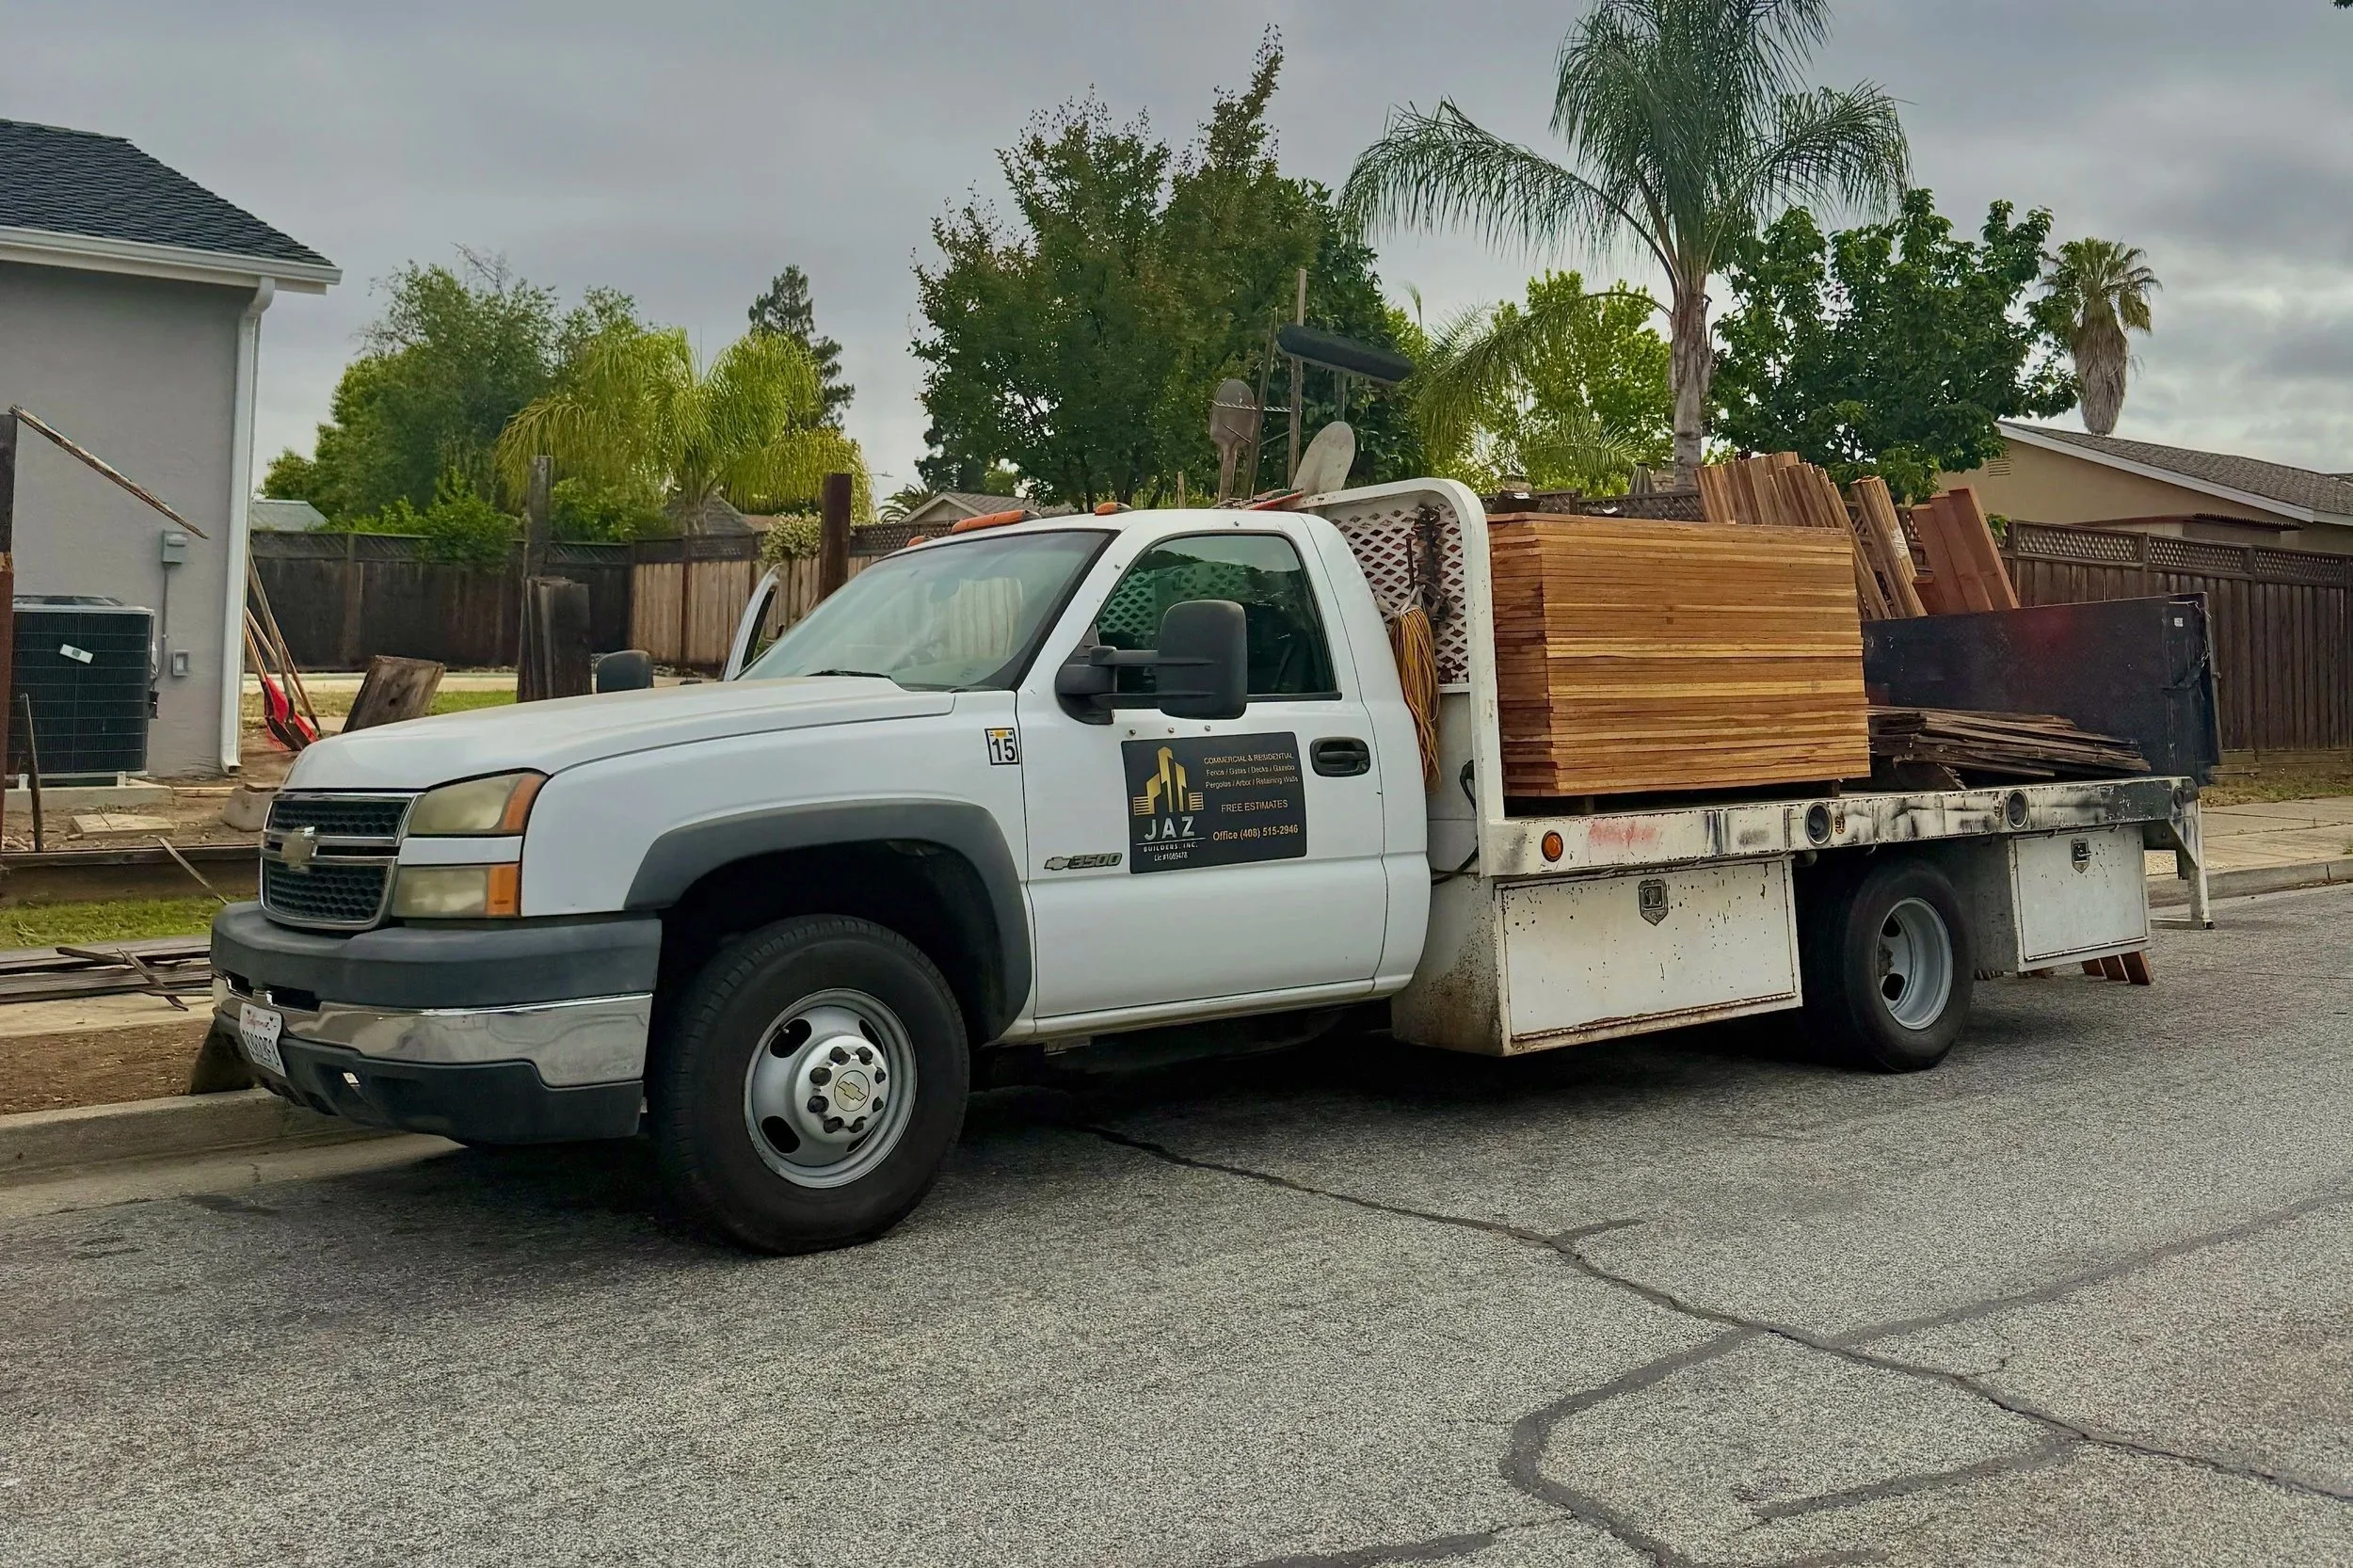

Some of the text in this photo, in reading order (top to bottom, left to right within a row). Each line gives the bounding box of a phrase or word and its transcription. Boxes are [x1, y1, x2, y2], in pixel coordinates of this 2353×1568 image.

[992, 738, 1016, 761] 15
[1204, 755, 1247, 764] COMMERCIAL
[1254, 753, 1294, 761] RESIDENTIAL
[1221, 799, 1289, 813] FREE ESTIMATES
[1144, 815, 1195, 840] JAZ
[1212, 824, 1299, 840] Office (408) 515-2946
[1068, 853, 1122, 869] 3500
